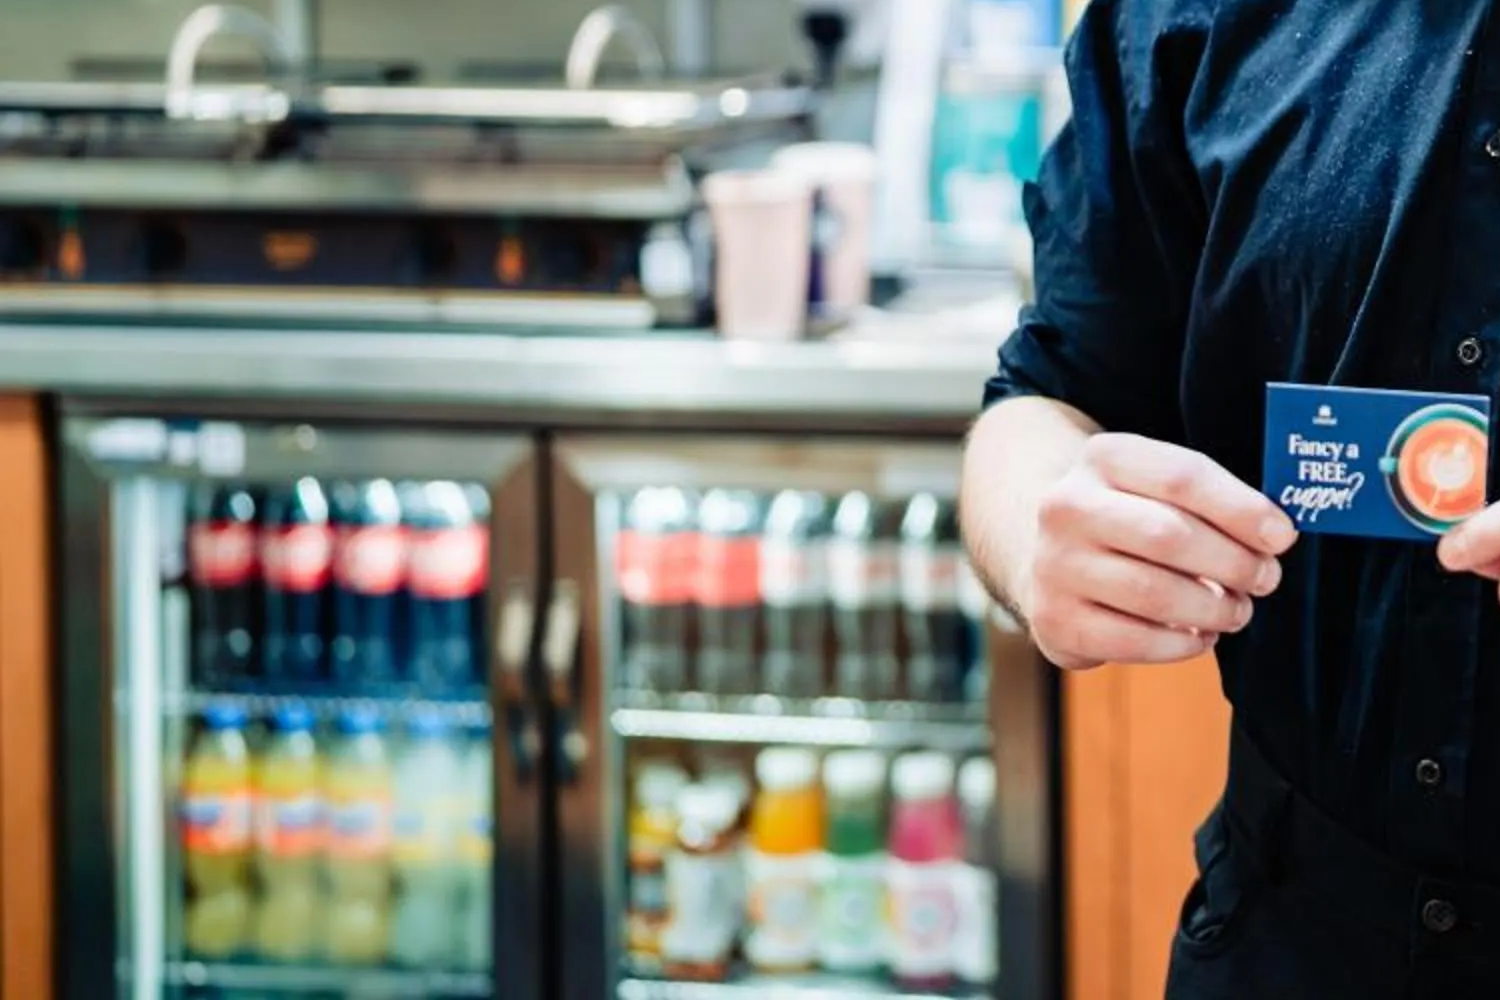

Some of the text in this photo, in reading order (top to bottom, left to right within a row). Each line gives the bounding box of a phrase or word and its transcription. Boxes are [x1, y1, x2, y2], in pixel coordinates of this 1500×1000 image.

[1289, 433, 1359, 461] Fancy a
[1299, 461, 1348, 483] FREE
